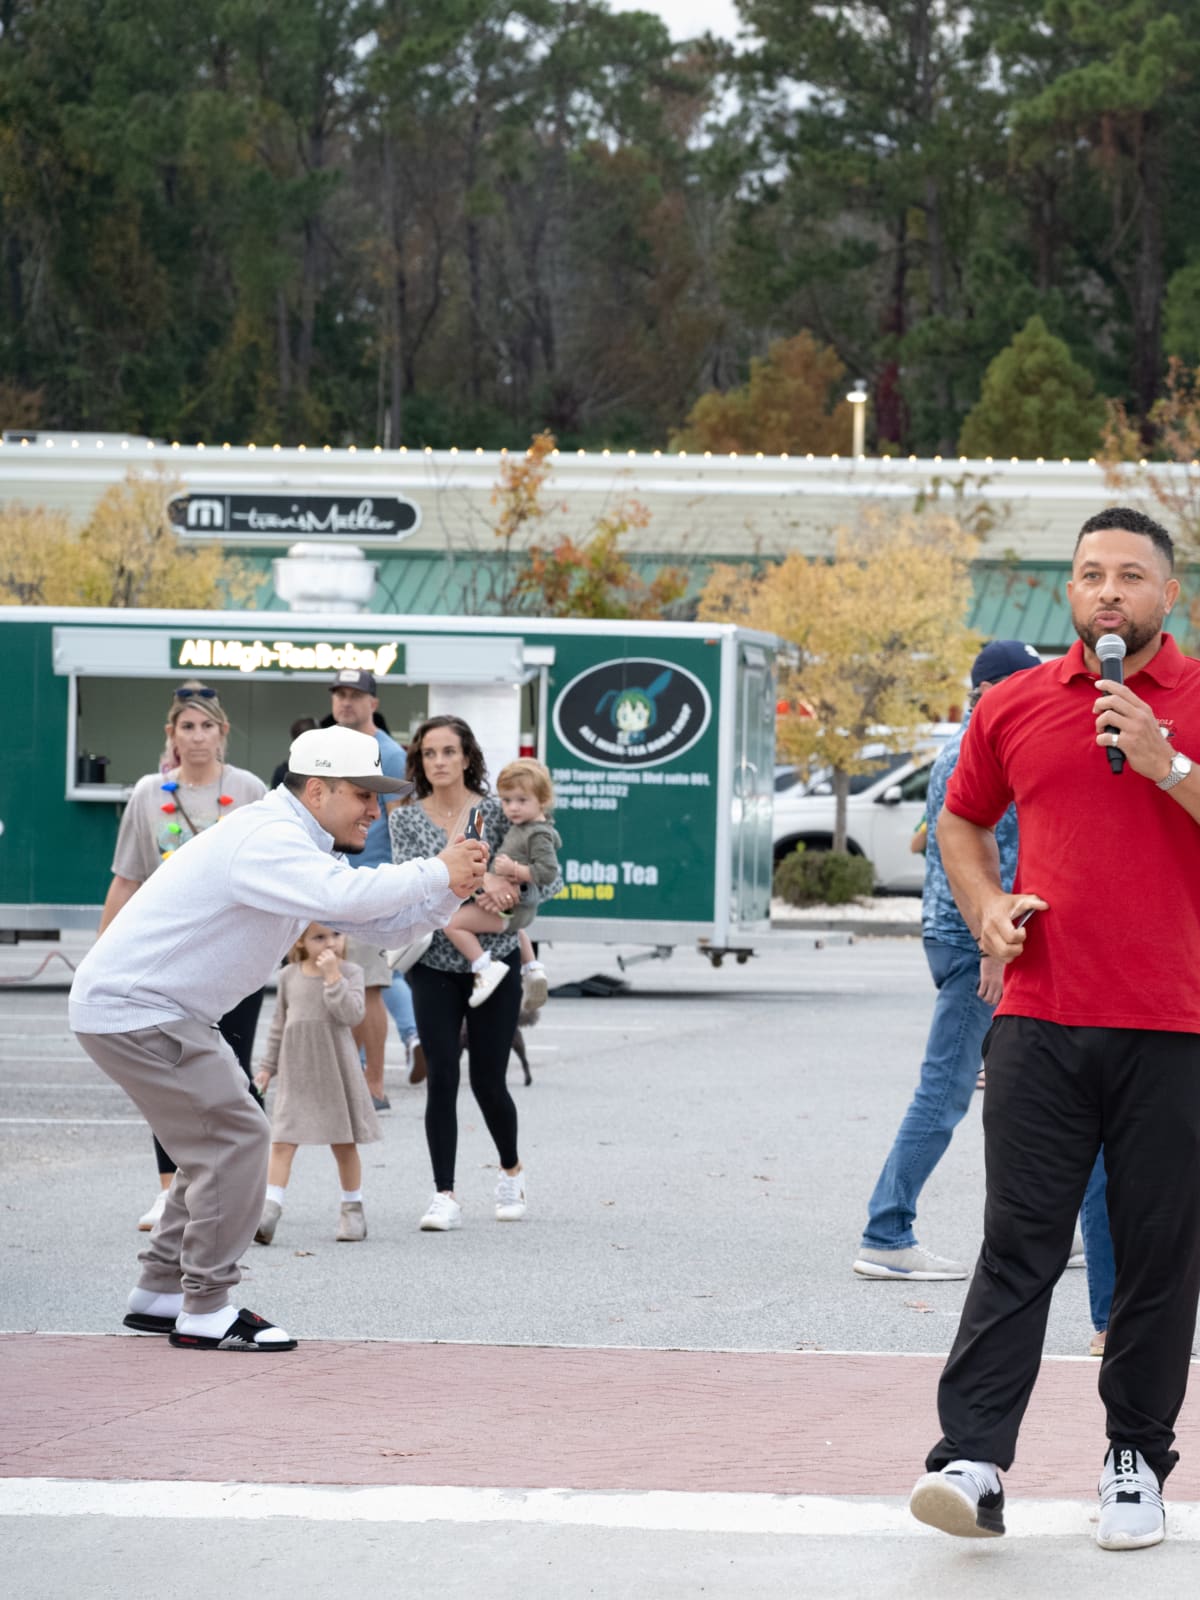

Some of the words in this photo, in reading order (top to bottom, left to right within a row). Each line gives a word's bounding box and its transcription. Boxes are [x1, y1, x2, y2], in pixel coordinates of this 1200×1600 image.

[179, 639, 211, 666] All
[566, 859, 618, 883] Boba
[621, 861, 659, 885] Tea
[570, 883, 594, 900] The
